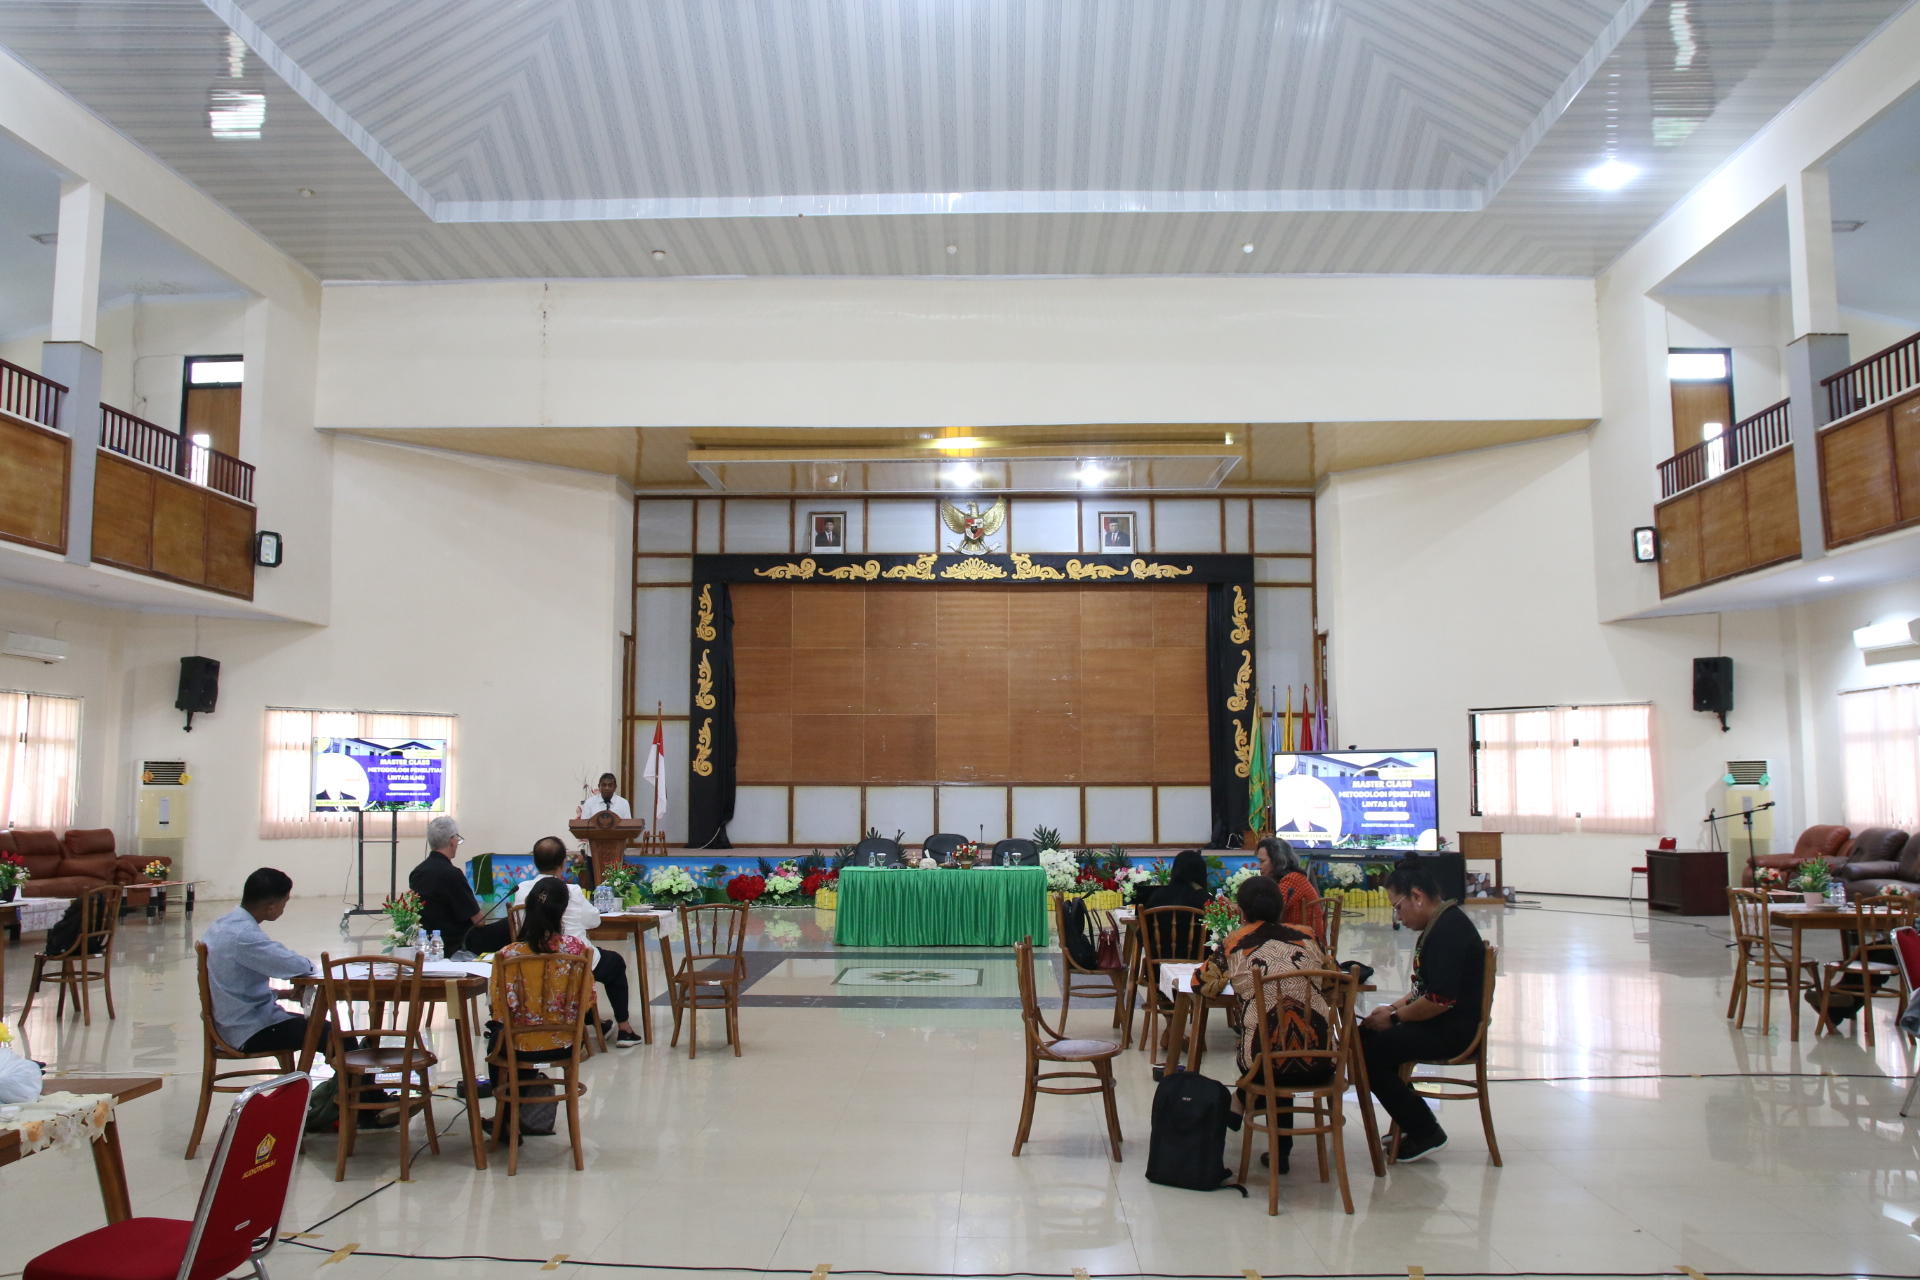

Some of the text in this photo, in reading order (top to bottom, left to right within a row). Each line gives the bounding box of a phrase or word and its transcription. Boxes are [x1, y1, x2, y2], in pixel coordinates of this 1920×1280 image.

[1386, 780, 1412, 788] CLASS
[1388, 790, 1431, 798] PENELITIAN
[1361, 800, 1407, 808] LINTAS ILMU
